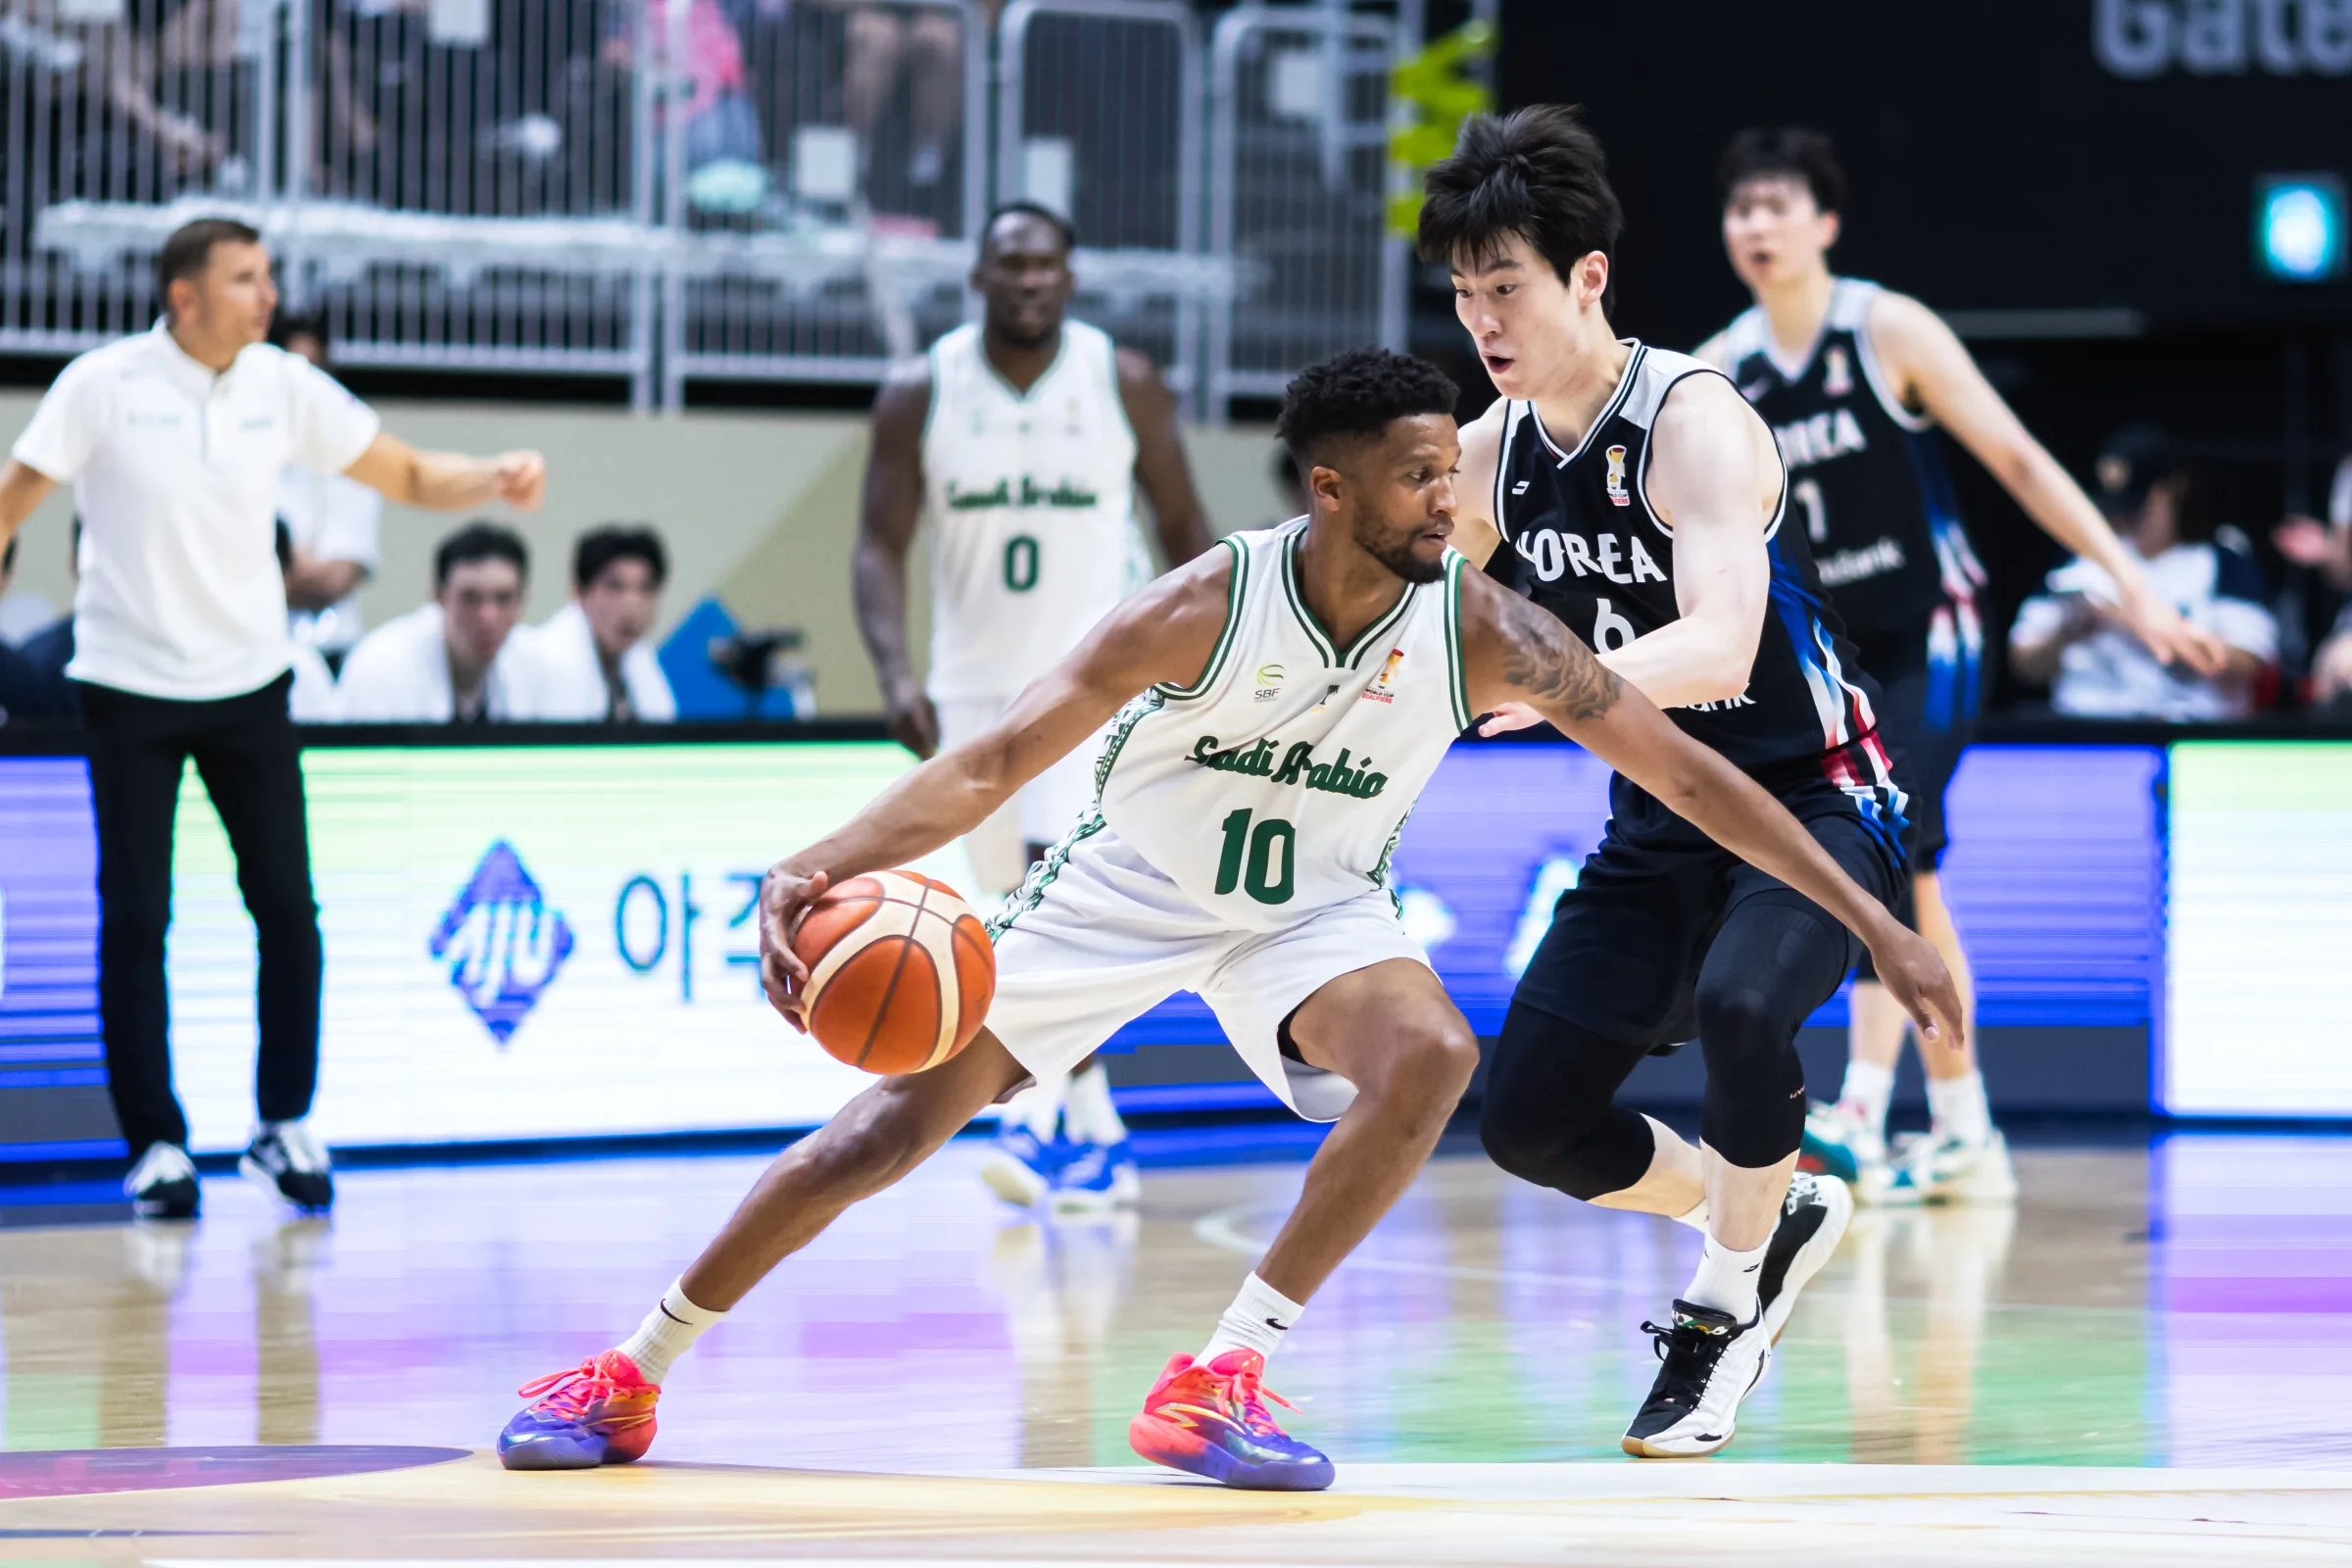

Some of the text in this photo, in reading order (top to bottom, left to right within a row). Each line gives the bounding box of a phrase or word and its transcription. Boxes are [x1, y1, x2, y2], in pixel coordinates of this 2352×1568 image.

[1004, 534, 1039, 591] 0
[1593, 598, 1636, 655] 6
[1254, 688, 1281, 699] SBF
[1271, 741, 1389, 799] Arabia
[1214, 808, 1296, 905] 10
